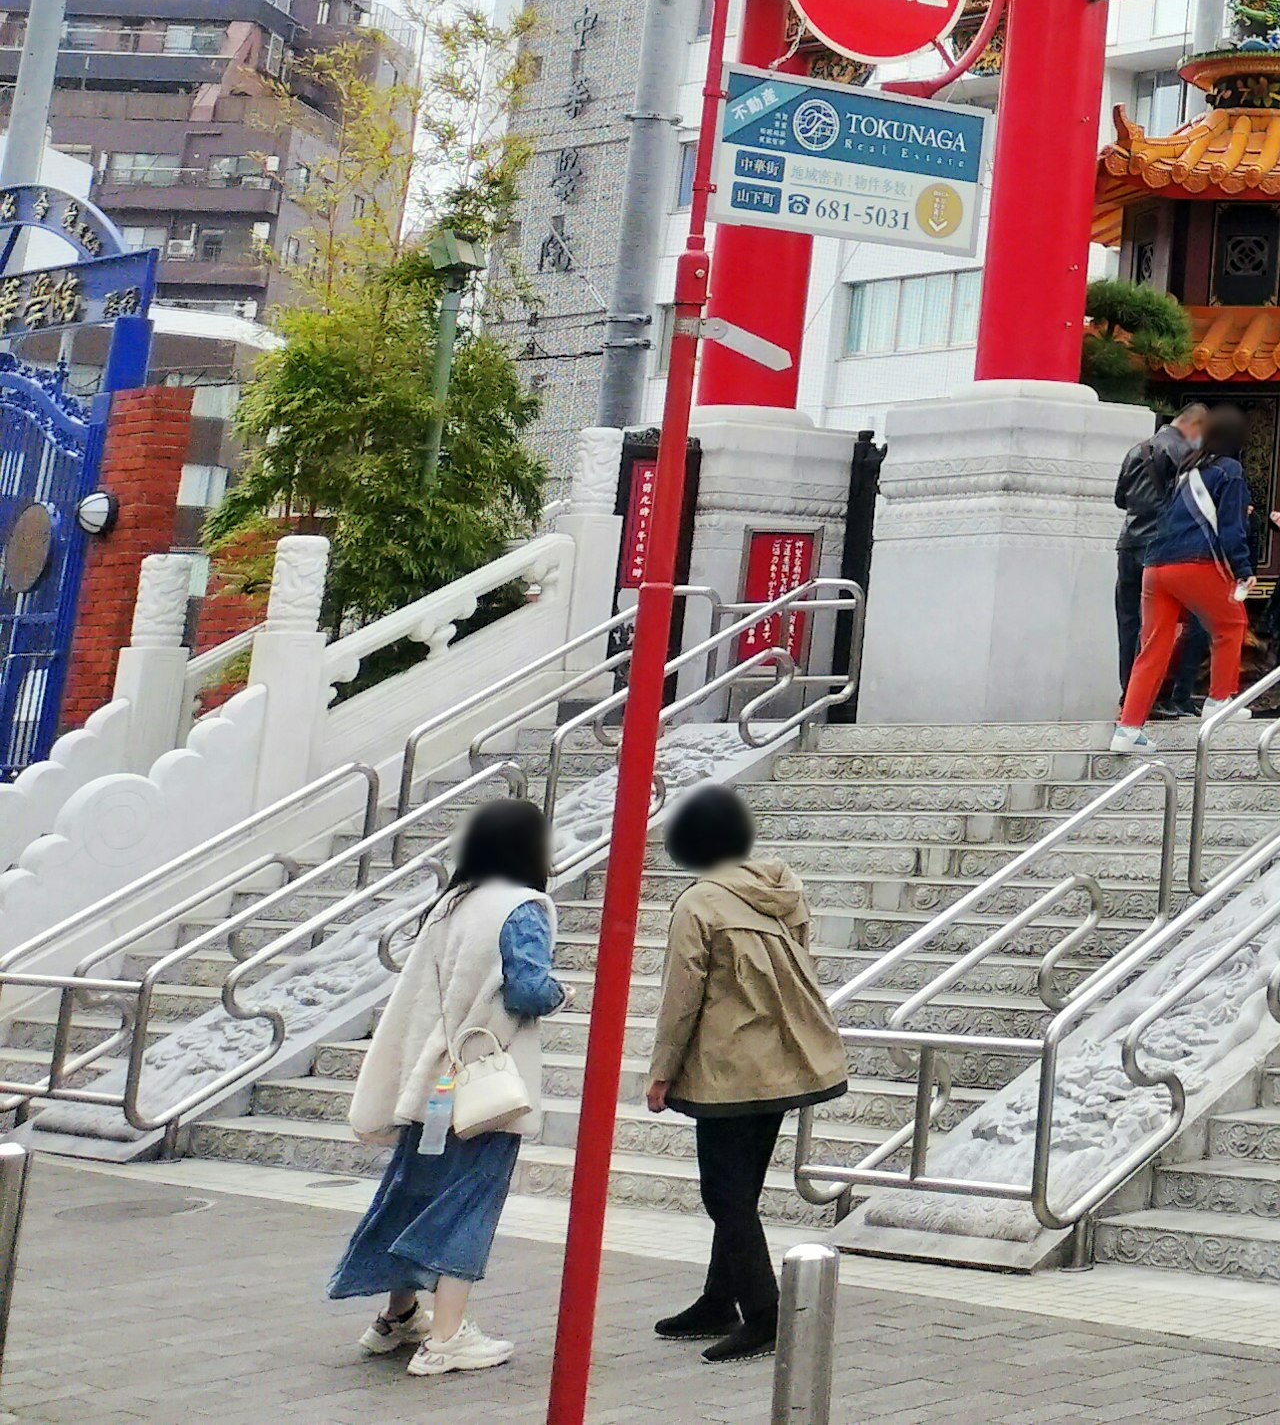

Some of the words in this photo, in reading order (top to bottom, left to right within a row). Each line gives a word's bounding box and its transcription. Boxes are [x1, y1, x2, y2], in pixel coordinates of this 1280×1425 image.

[731, 87, 779, 122] 不動産
[845, 112, 967, 153] TOKUNAGA
[740, 157, 780, 177] 中華街
[844, 138, 887, 157] Real
[901, 147, 966, 169] Estate
[736, 188, 776, 208] 山下町
[815, 199, 911, 231] 681-5031
